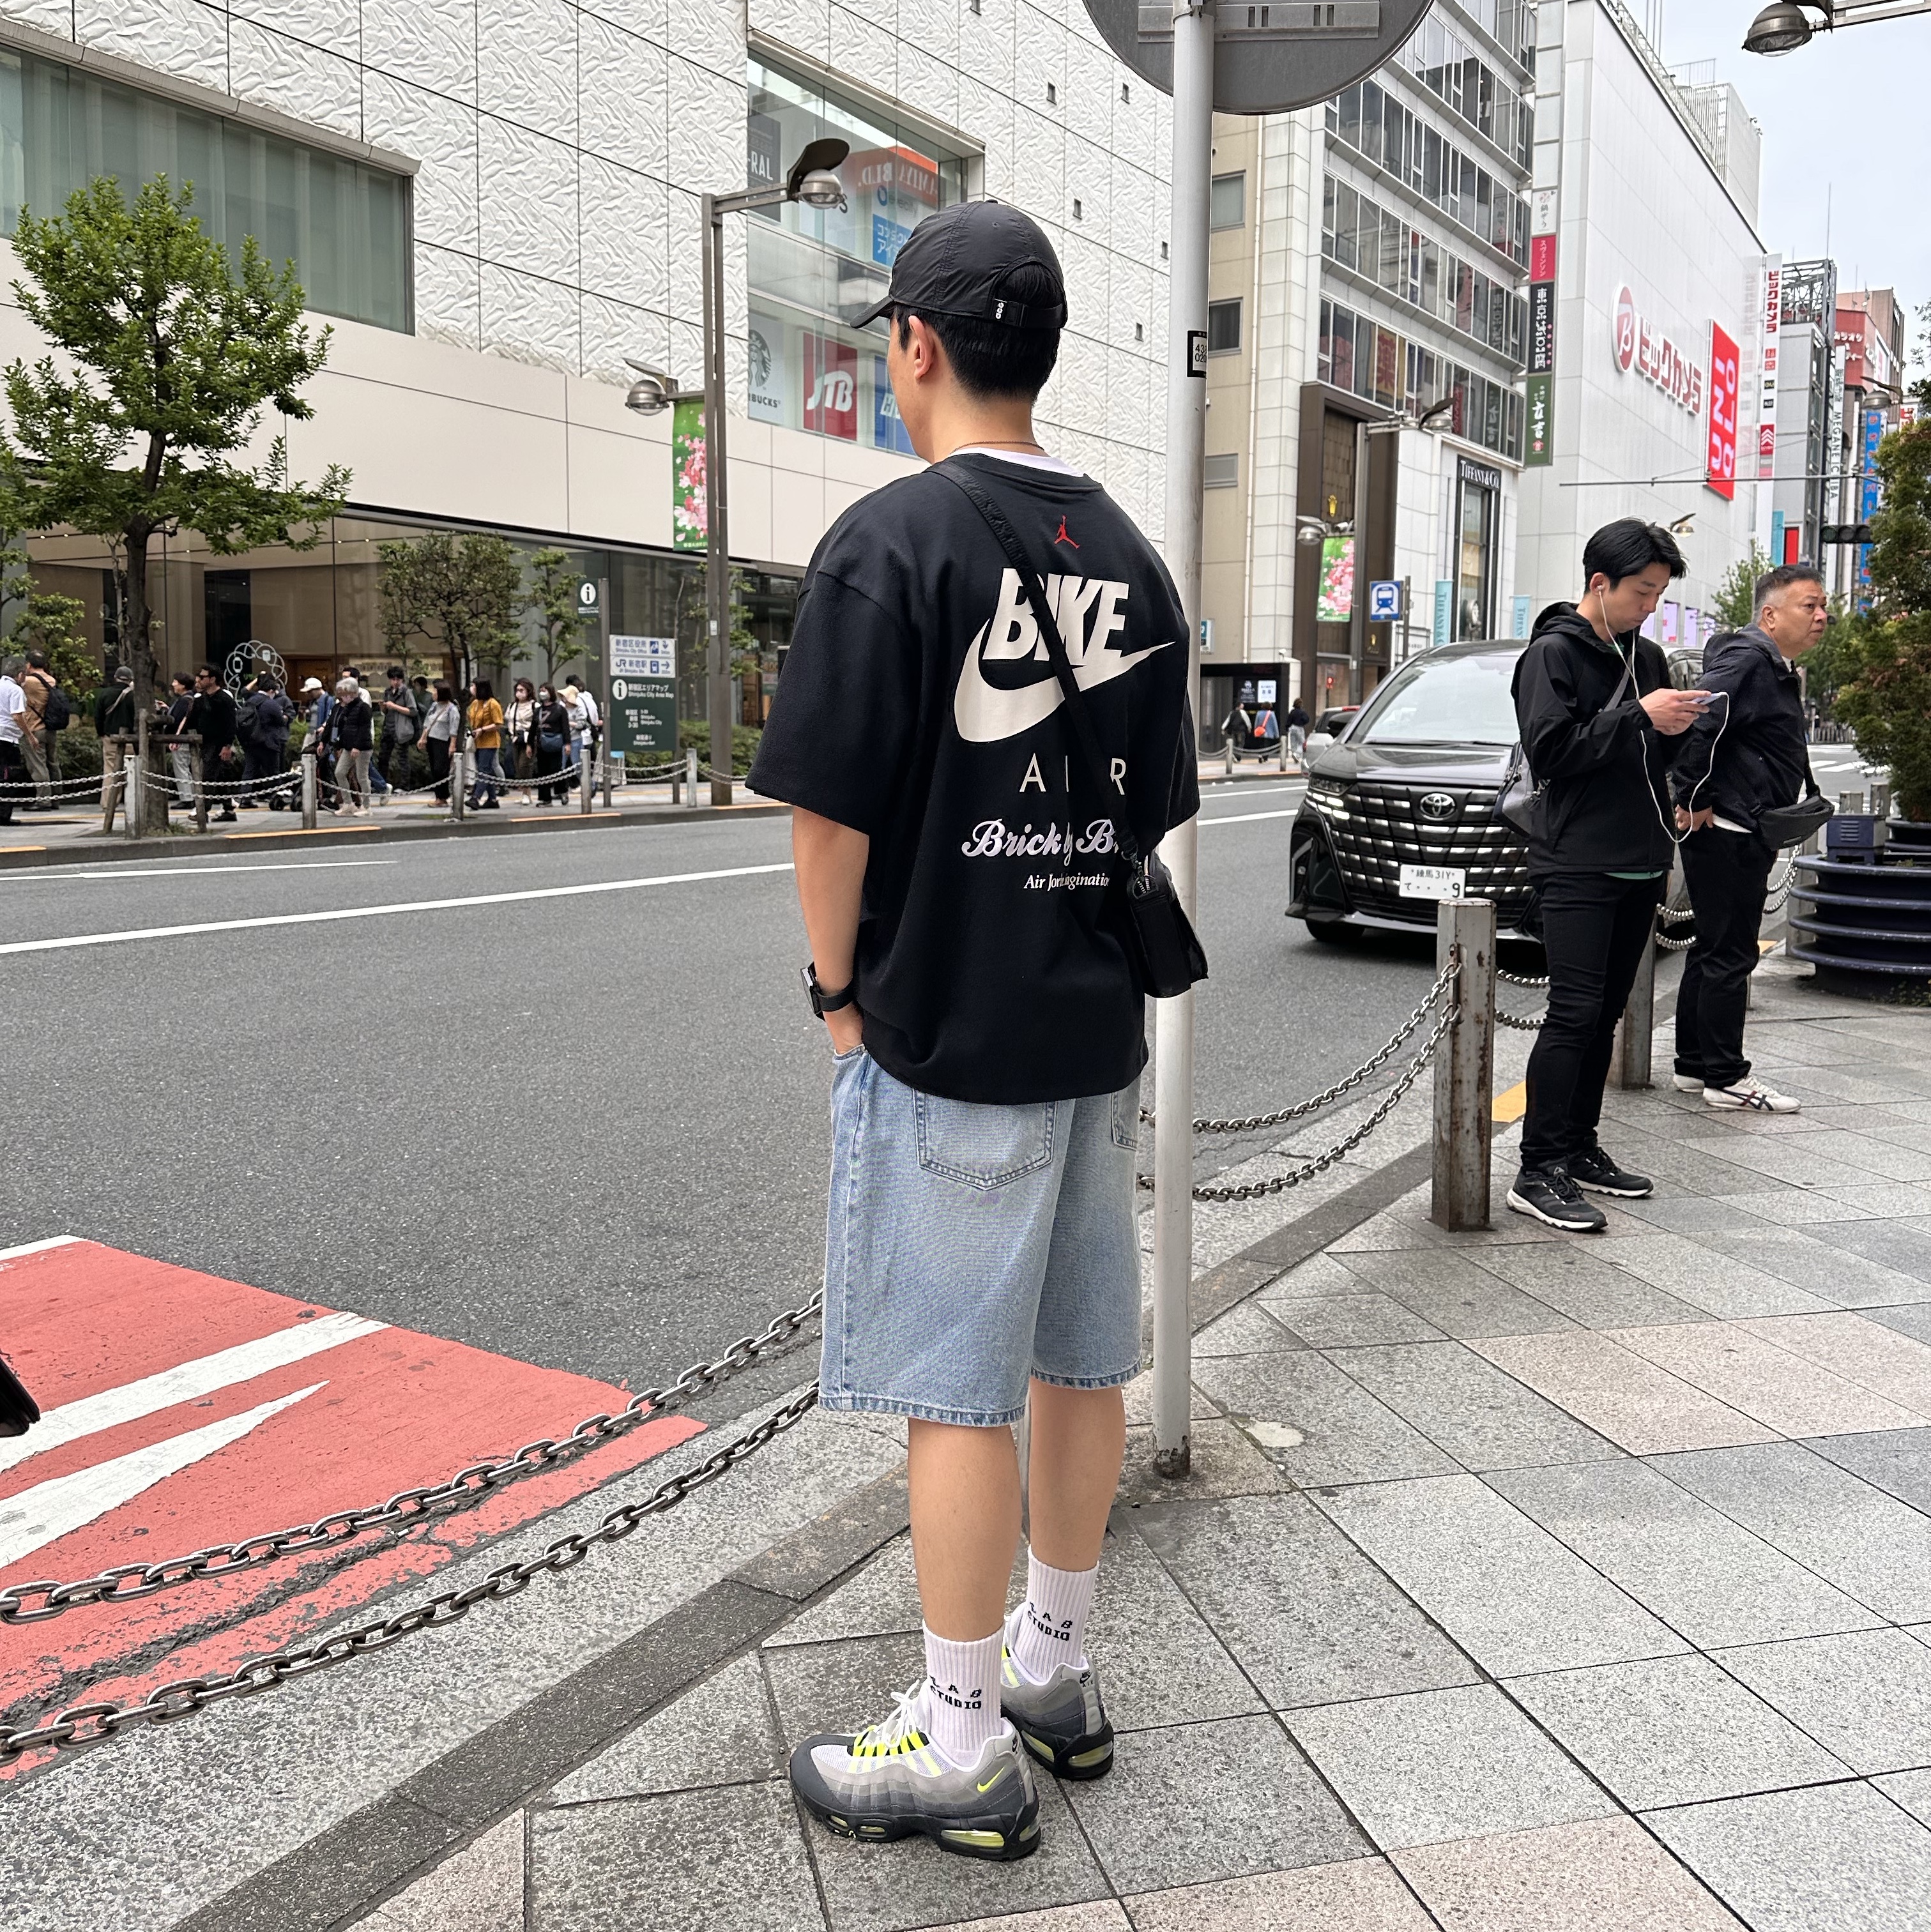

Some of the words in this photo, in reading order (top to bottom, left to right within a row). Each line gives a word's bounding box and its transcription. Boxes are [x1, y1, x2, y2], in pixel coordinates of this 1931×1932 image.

[1766, 270, 1779, 333] ビックカメラ
[1639, 314, 1702, 415] ビックカメラ
[807, 370, 853, 412] JTB
[1829, 462, 1840, 499] ICIBA
[616, 658, 627, 667] JR
[961, 818, 1062, 857] Brick
[1023, 874, 1046, 889] Air
